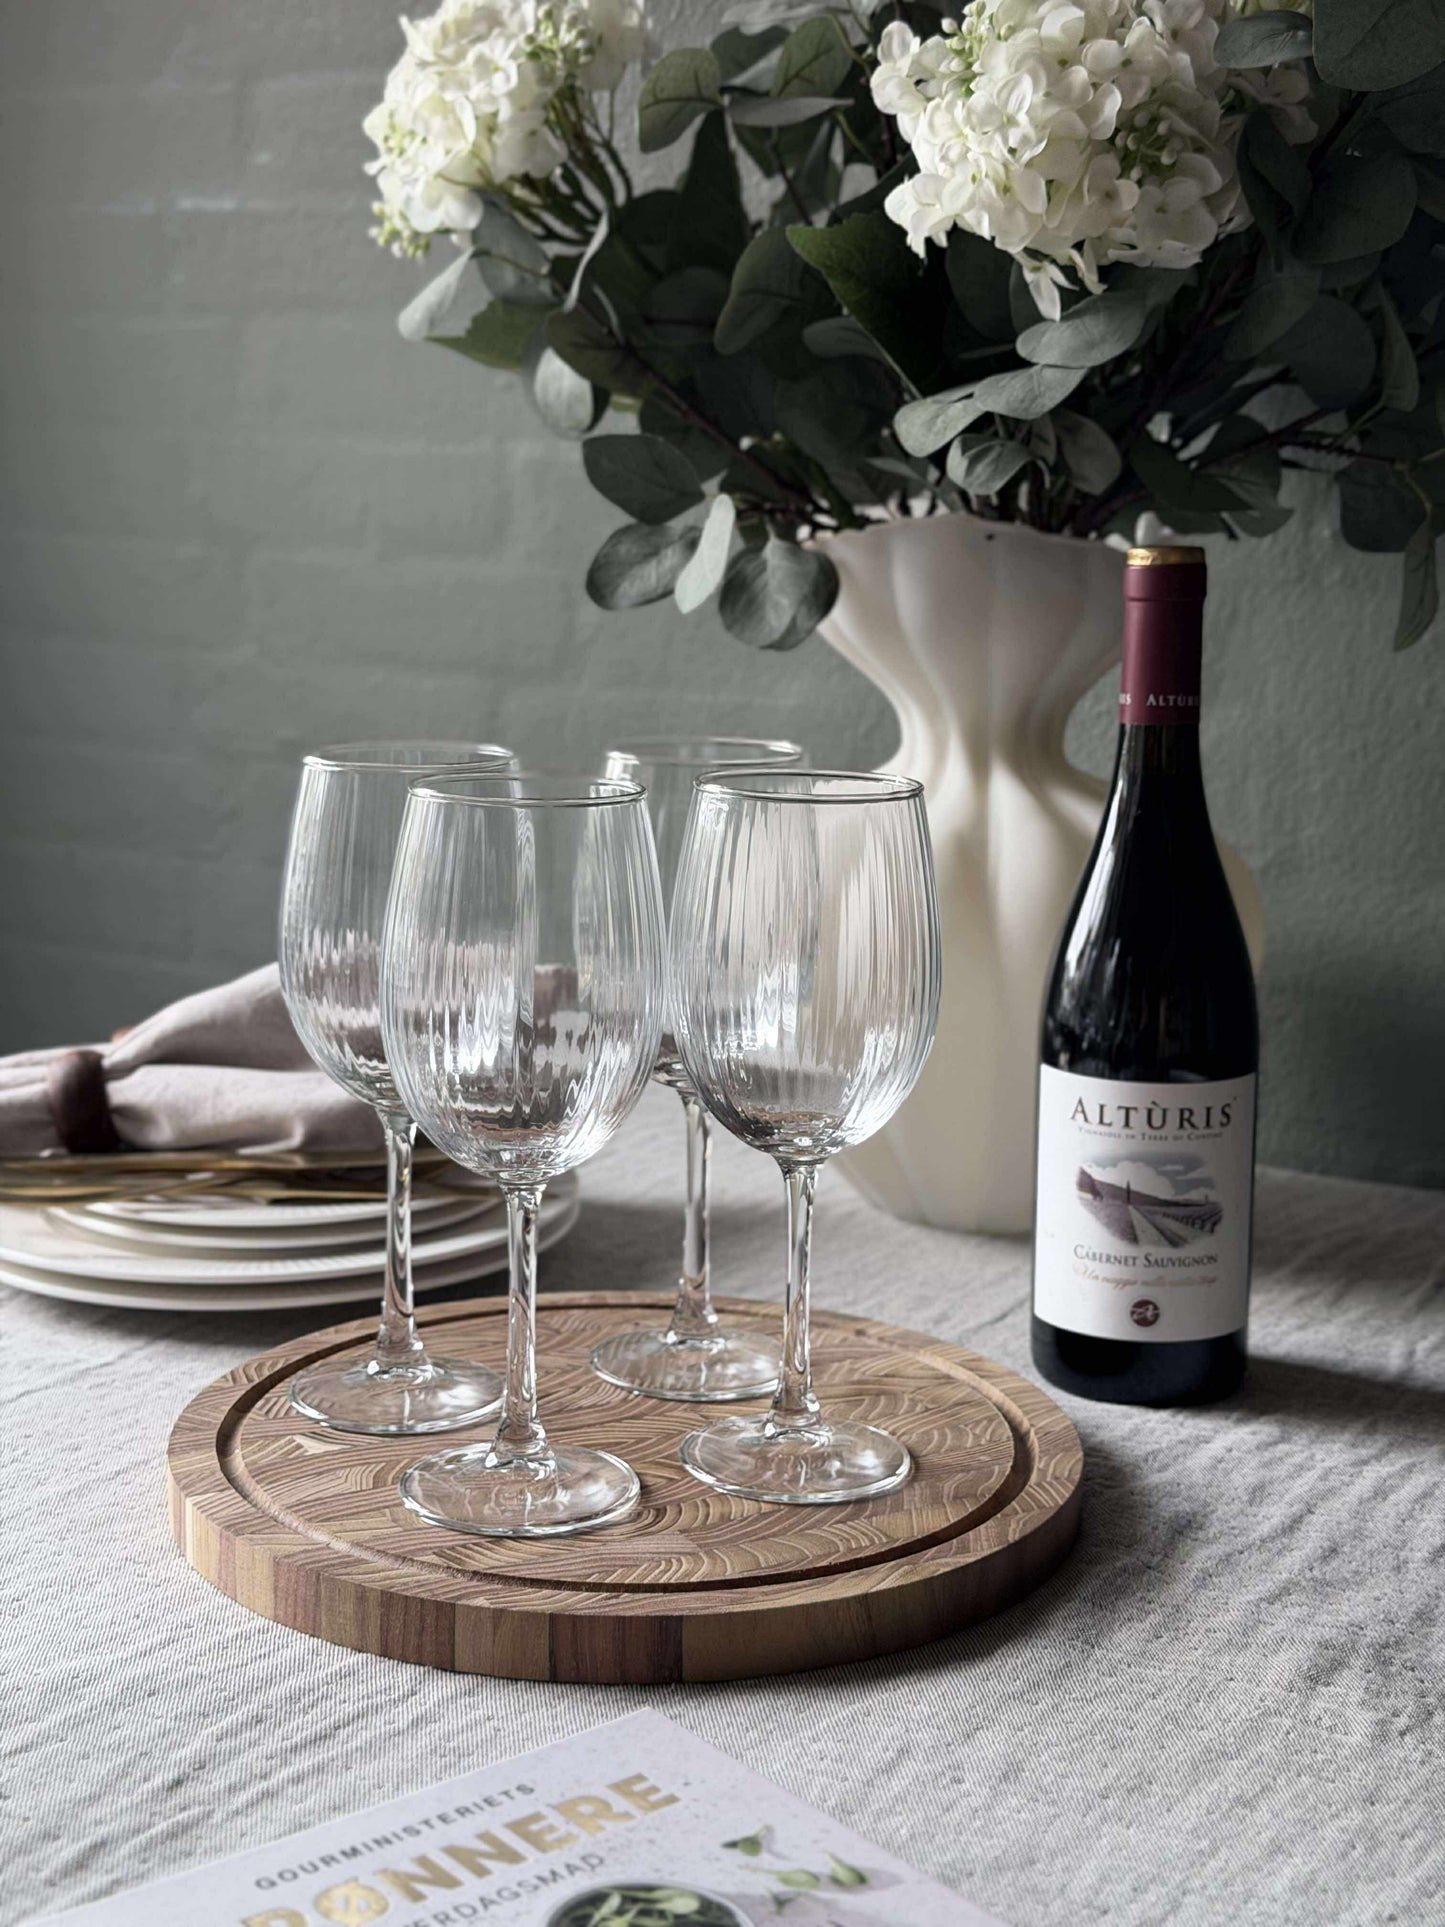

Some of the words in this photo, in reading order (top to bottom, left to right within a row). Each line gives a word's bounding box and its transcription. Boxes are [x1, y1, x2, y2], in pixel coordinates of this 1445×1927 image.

[1070, 1096, 1232, 1131] ALTÙRIS
[1073, 1243, 1139, 1268] CABERNET
[1143, 1252, 1219, 1269] SAUVIGNON
[254, 1782, 536, 1892] GOURMINISTERIETS
